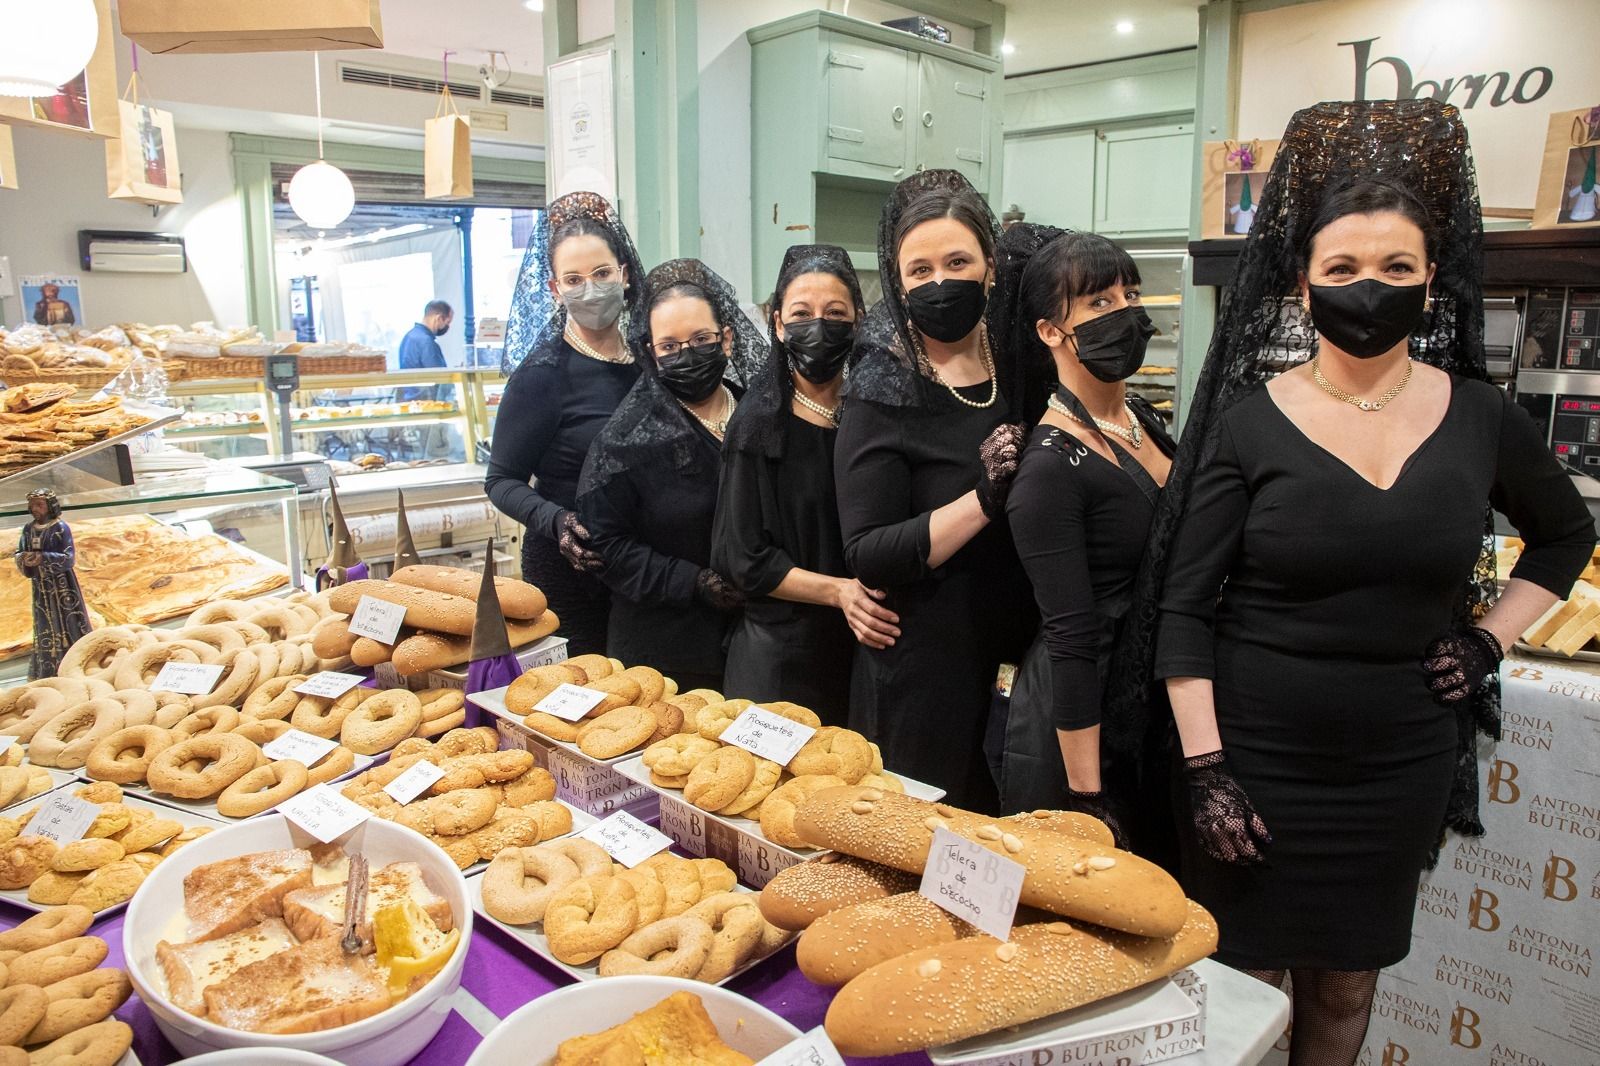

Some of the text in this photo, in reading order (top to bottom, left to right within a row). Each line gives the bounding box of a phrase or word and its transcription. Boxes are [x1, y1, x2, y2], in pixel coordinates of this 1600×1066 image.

[748, 713, 794, 738] Rosquetes
[751, 729, 763, 739] de
[1501, 710, 1553, 733] TONIA
[735, 734, 758, 749] Nata
[1501, 728, 1552, 752] TRÓN
[1487, 753, 1520, 805] B
[1530, 794, 1600, 822] ANTONI
[690, 813, 702, 837] B
[756, 845, 770, 872] B
[945, 844, 977, 871] Telera
[1455, 842, 1533, 874] ANTONIA
[955, 870, 967, 885] de
[1542, 849, 1578, 902] B
[940, 881, 981, 914] bizcocho
[1420, 882, 1460, 904] ONIA
[1467, 882, 1501, 932] B
[1511, 924, 1593, 961] ANTONIA
[1437, 954, 1514, 989] ANTONIA
[1450, 999, 1482, 1050] B
